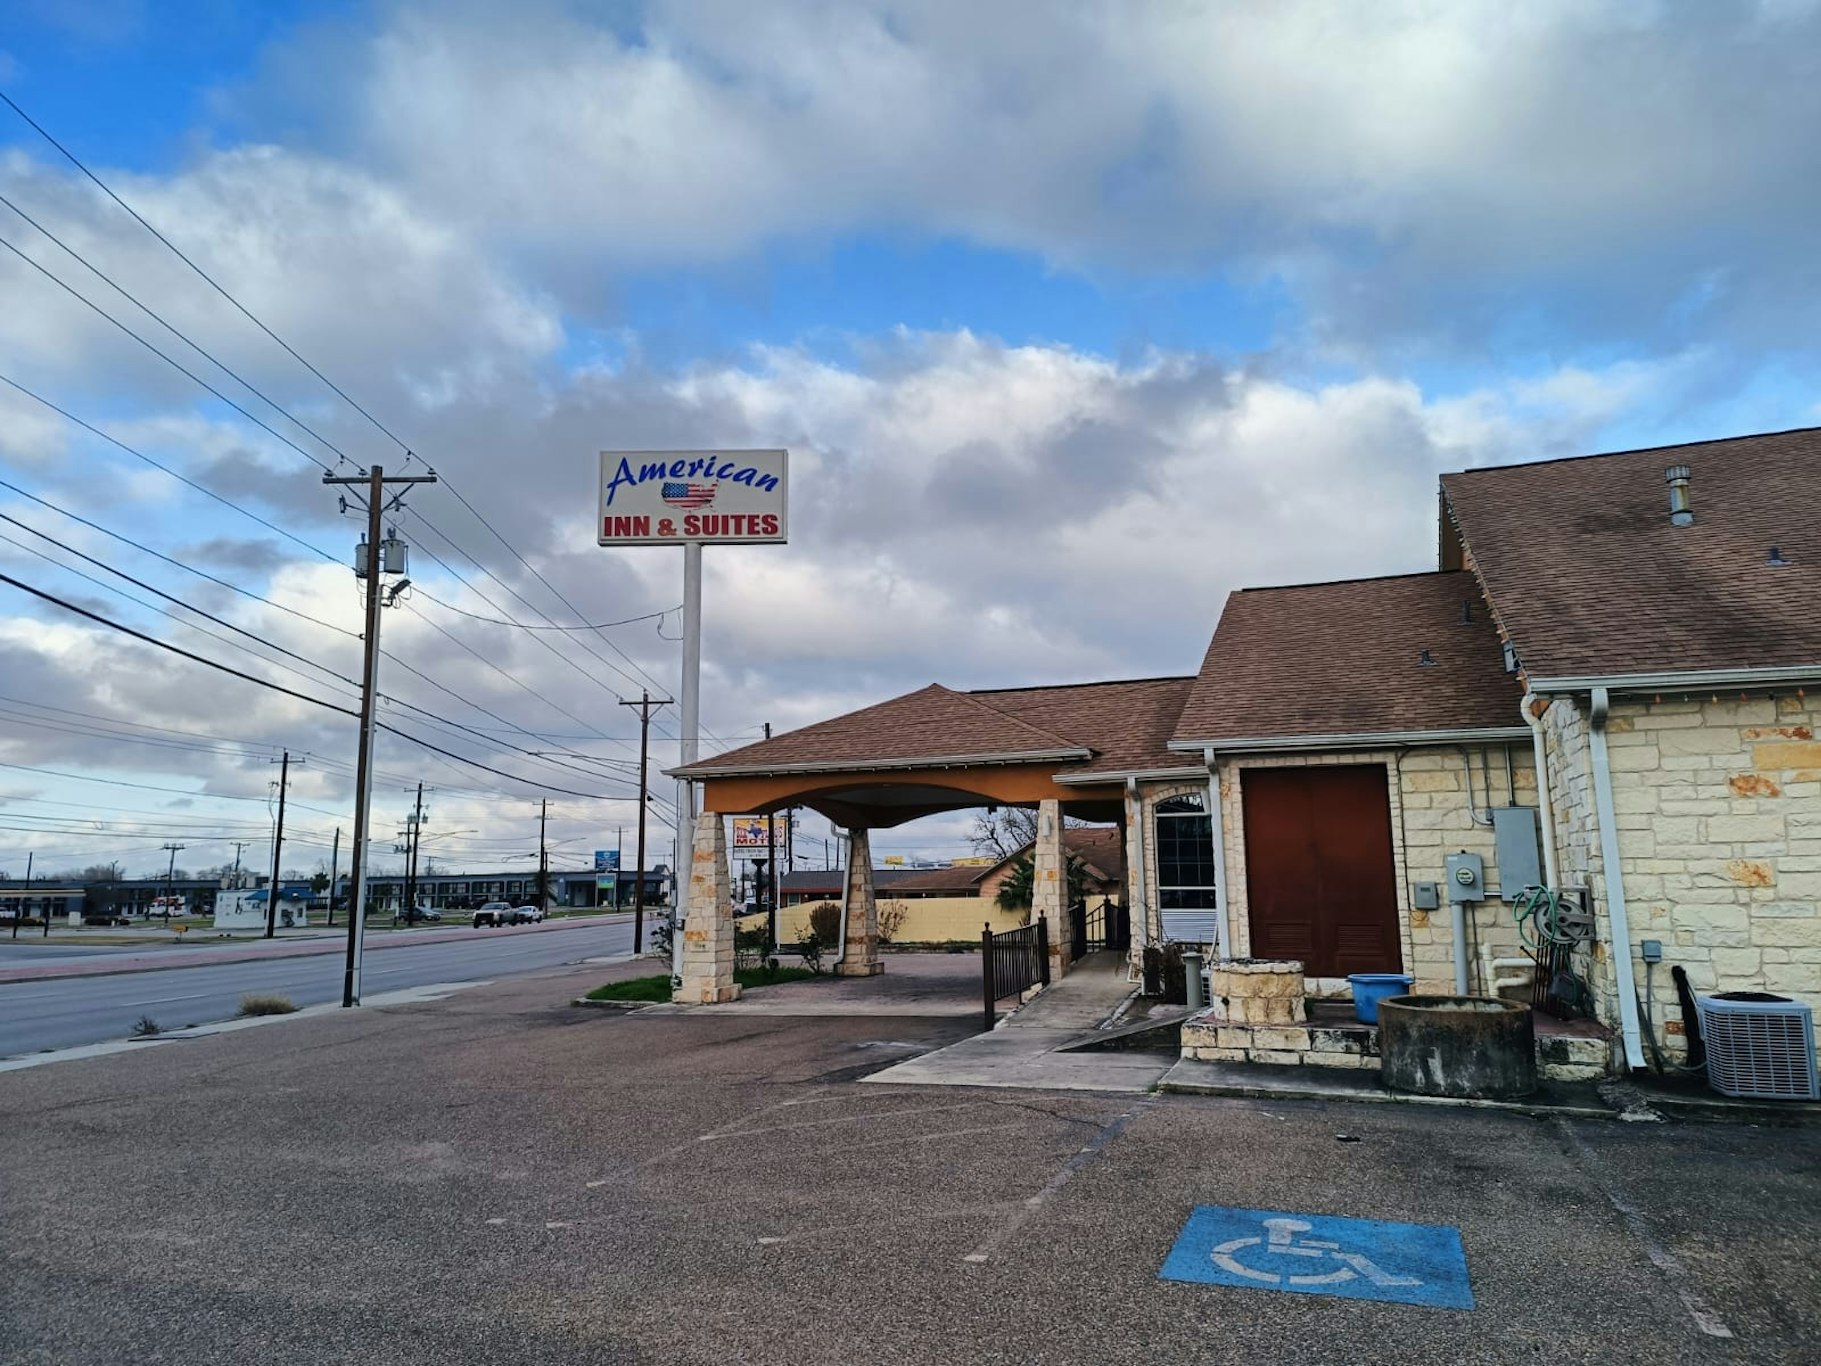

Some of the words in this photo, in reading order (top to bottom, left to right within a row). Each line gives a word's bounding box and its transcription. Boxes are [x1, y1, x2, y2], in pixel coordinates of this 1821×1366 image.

[606, 455, 779, 507] American
[604, 515, 650, 537] INN
[657, 518, 678, 536] &
[683, 514, 779, 536] SUITES
